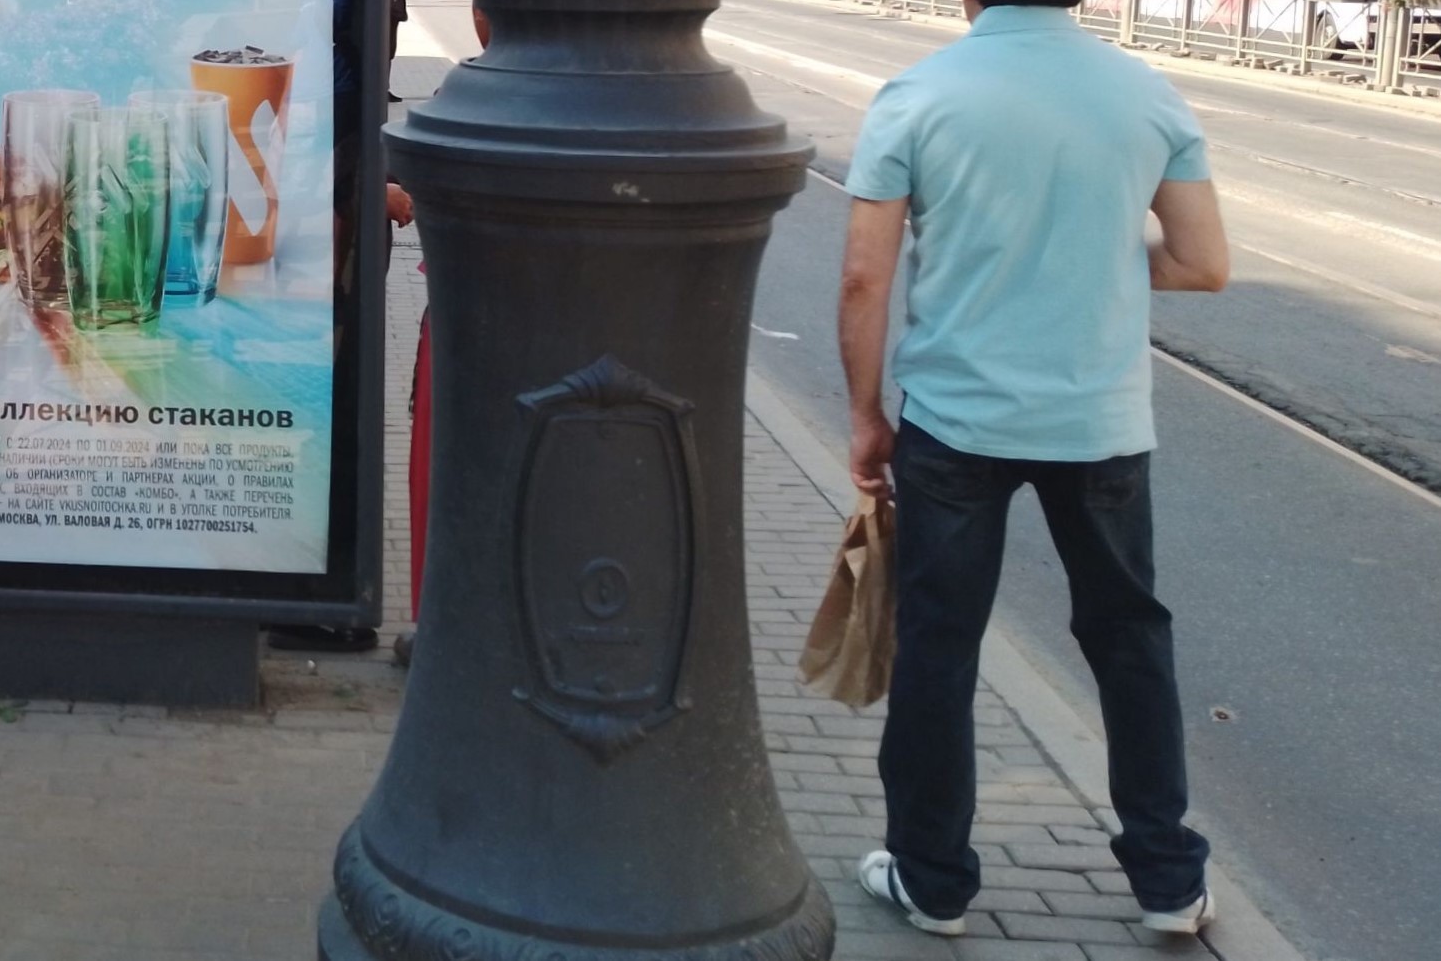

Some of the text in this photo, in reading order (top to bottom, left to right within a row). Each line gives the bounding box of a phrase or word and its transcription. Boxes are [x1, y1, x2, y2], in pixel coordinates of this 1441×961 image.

[148, 406, 294, 429] стаканов
[6, 437, 13, 449] С
[17, 438, 71, 451] 22.07.2024
[76, 439, 91, 451] ПО
[96, 440, 150, 453] 01.09.2024
[156, 442, 177, 455] ИЛИ
[183, 442, 210, 455] ПОКА
[215, 443, 233, 456] ВСЕ
[88, 456, 119, 468] МОГУТ
[122, 456, 147, 468] БЫТЬ
[150, 457, 206, 470] ИЗМЕНЕНЫ
[209, 458, 223, 470] ПО
[5, 468, 19, 480] ОБ
[106, 471, 113, 482] И
[122, 471, 174, 484] ПАРТНЕРАХ
[227, 475, 235, 486] О
[243, 475, 294, 488] ПРАВИЛАХ
[14, 483, 68, 496] ВХОДЯЩИХ
[77, 485, 83, 496] В
[91, 485, 127, 498] СОСТАВ
[190, 489, 197, 501] А
[204, 489, 236, 502] ТАКЖЕ
[243, 490, 294, 504] ПЕРЕЧЕНЬ
[7, 498, 21, 510] НА
[25, 497, 55, 511] САЙТЕ
[59, 499, 152, 514] VKUSNOITOCHKA.RU
[157, 504, 164, 515] И
[170, 504, 177, 515] В
[181, 504, 217, 517] УГОЛКЕ
[45, 514, 61, 526] УЛ.
[64, 515, 110, 528] ВАЛОВАЯ
[114, 516, 125, 529] Д.
[128, 517, 144, 530] 26,
[146, 517, 173, 530] ОГРН
[175, 518, 258, 534] 1027700251754.
